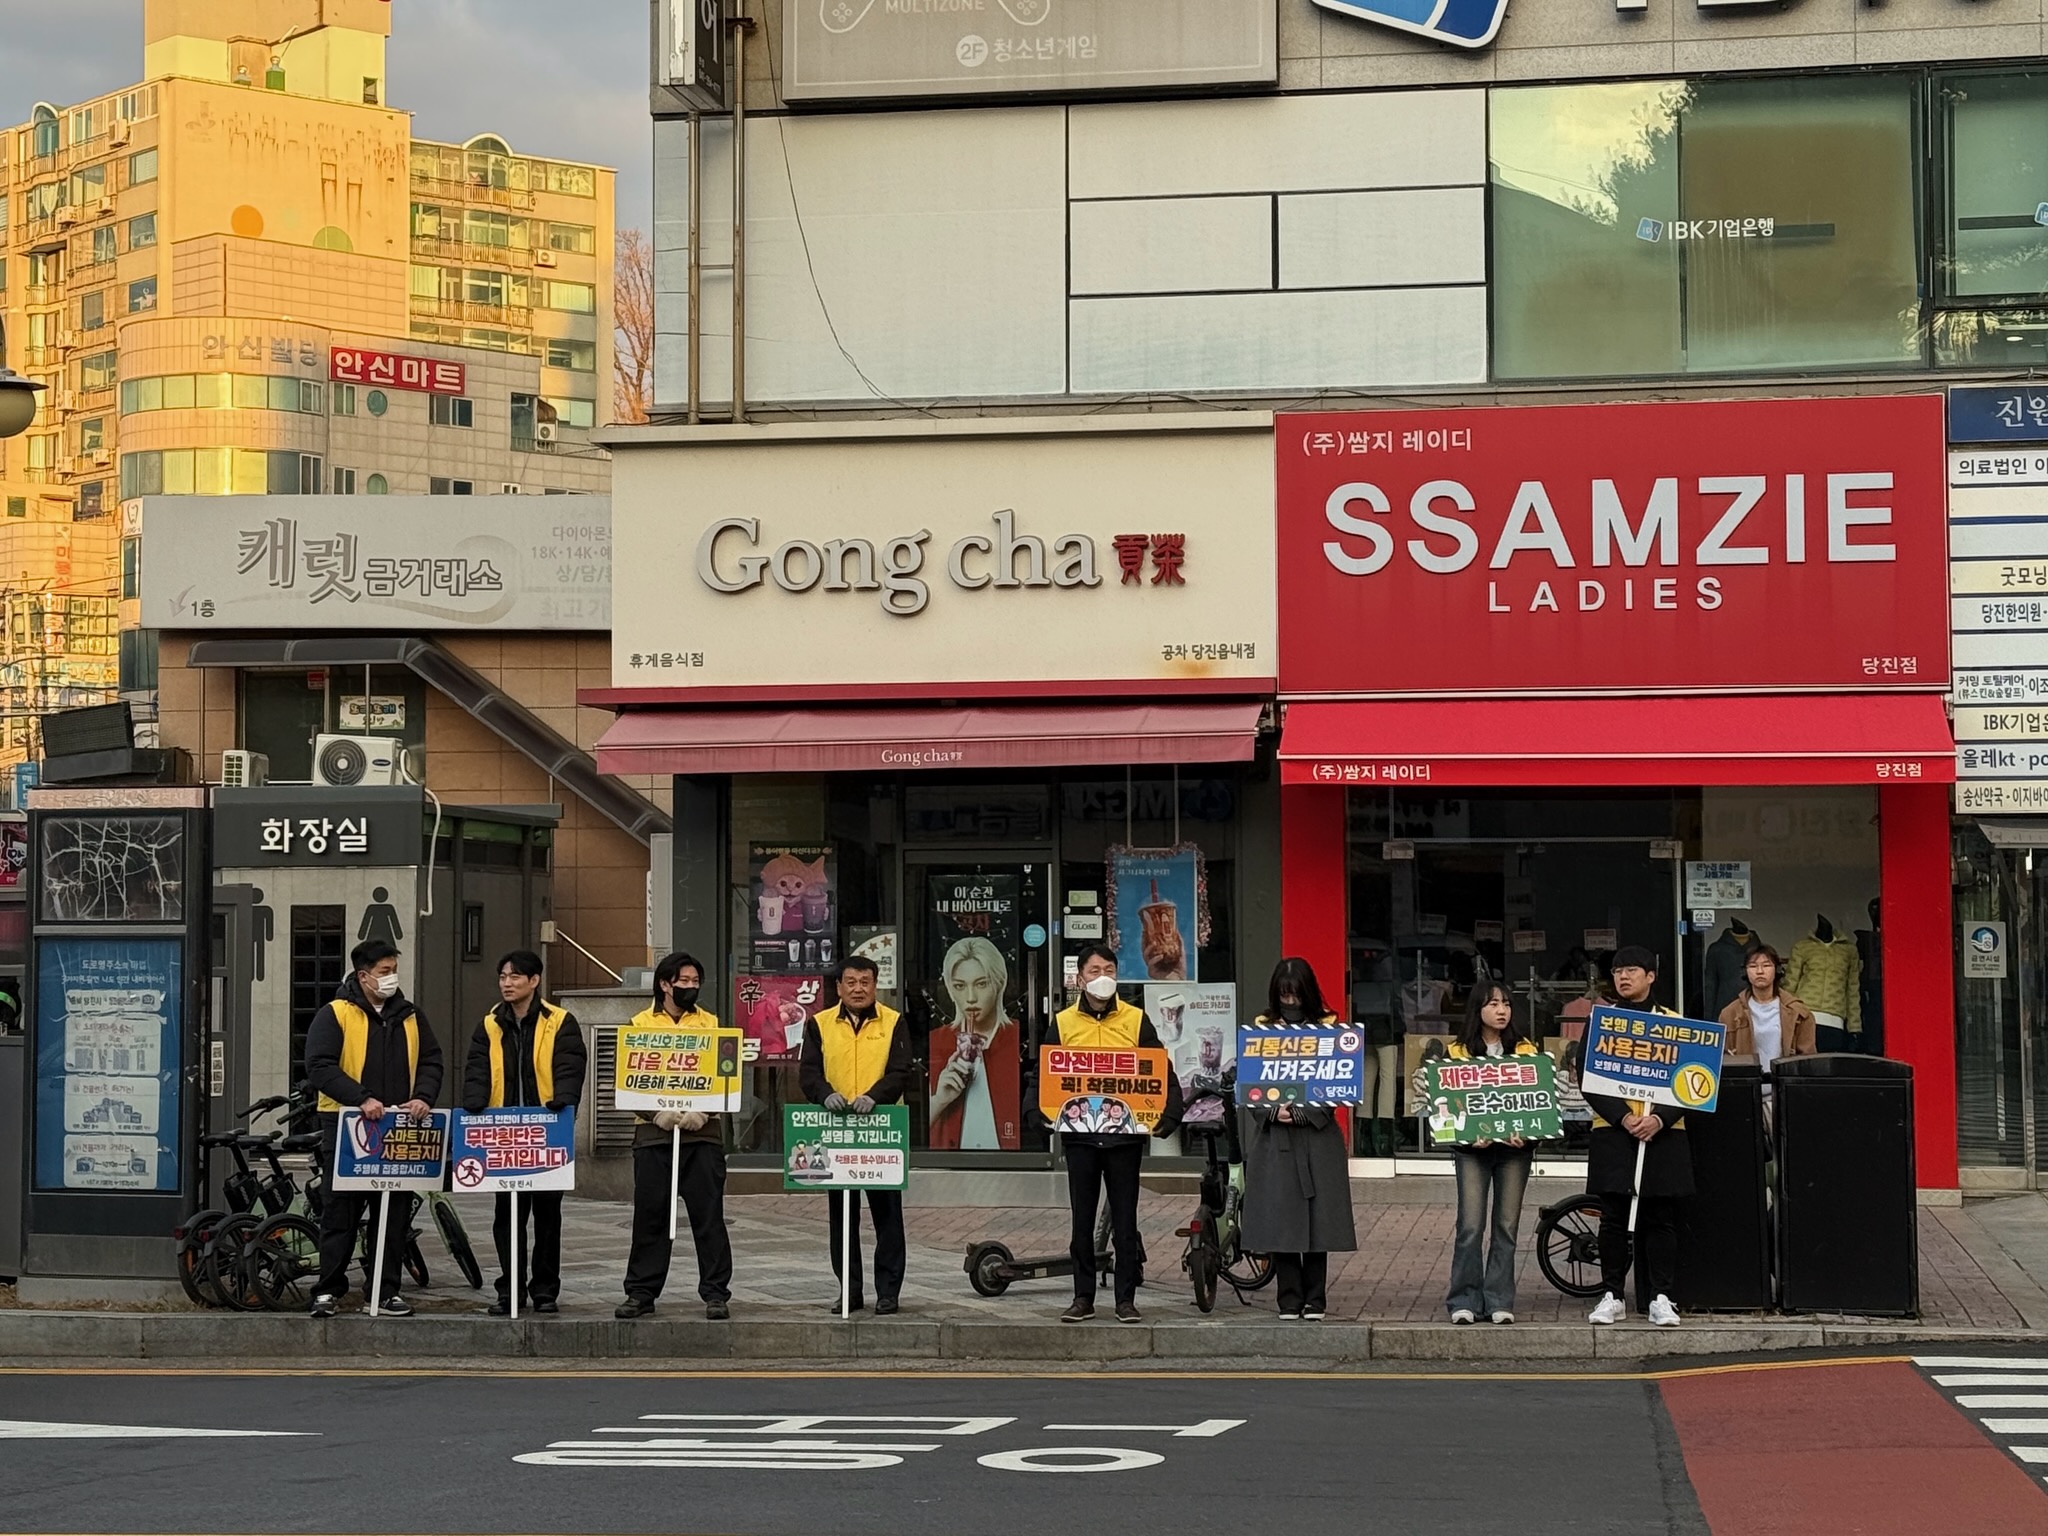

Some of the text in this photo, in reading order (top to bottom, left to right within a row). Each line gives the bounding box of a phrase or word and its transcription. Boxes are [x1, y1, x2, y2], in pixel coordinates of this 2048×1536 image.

[960, 35, 1098, 62] 2F 청소년게임
[202, 335, 318, 367] 안신빌딩
[333, 352, 464, 392] 안신마트
[1302, 428, 1473, 456] (주)쌈지 레이디
[1958, 458, 2028, 477] 의료법인
[1323, 471, 1897, 575] SSAMZIE
[237, 517, 503, 604] 캐럿 금거래소
[697, 508, 1103, 617] Gong cha
[2001, 566, 2048, 587] 굿모닝
[1488, 576, 1725, 613] LADIES
[192, 600, 216, 618] 1층
[629, 651, 704, 668] 휴게음식점
[1162, 643, 1256, 661] 공차 당진읍내점
[1861, 656, 1918, 676] 당진점
[881, 749, 921, 766] Gong
[924, 748, 949, 762] cha
[1962, 749, 2016, 769] 올레kt
[1312, 763, 1431, 781] (주)쌈지 레이디
[1875, 761, 1922, 778] 당진점
[1963, 787, 2004, 808] 송산약국
[260, 816, 369, 855] 화장실
[954, 886, 993, 899] 이 순간
[936, 900, 1012, 913] 내 바이브대로
[1071, 923, 1098, 931] CLOSE
[796, 980, 820, 1004] 상
[625, 1033, 647, 1048] 녹색
[650, 1034, 672, 1048] 신호
[699, 1036, 711, 1050] 시
[1343, 1036, 1355, 1045] 30
[1600, 1015, 1720, 1048] 보행 중 스마트기기
[1243, 1036, 1336, 1058] 교통신호를
[1594, 1035, 1680, 1065] 사용금지!
[626, 1051, 700, 1072] 다음 신호
[1049, 1050, 1153, 1076] 안전벨트를
[1260, 1059, 1354, 1082] 지켜주세요
[625, 1075, 712, 1090] 이용해 주세요!
[1061, 1077, 1162, 1095] 꼭! 착용하세요
[1438, 1062, 1538, 1090] 제한속도를
[1325, 1085, 1357, 1098] 당진시
[1629, 1087, 1655, 1099] 당진시
[1466, 1091, 1552, 1116] 준수하세요
[791, 1111, 890, 1127] 안전띠는 운전자의
[1136, 1112, 1162, 1122] 당진시
[383, 1129, 441, 1144] 스마트기기
[464, 1126, 547, 1148] 무단횡단은
[821, 1130, 902, 1144] 생명을 지킵니다
[381, 1144, 440, 1161] 사용금지!
[487, 1148, 567, 1169] 금지입니다
[859, 1170, 883, 1179] 당진시
